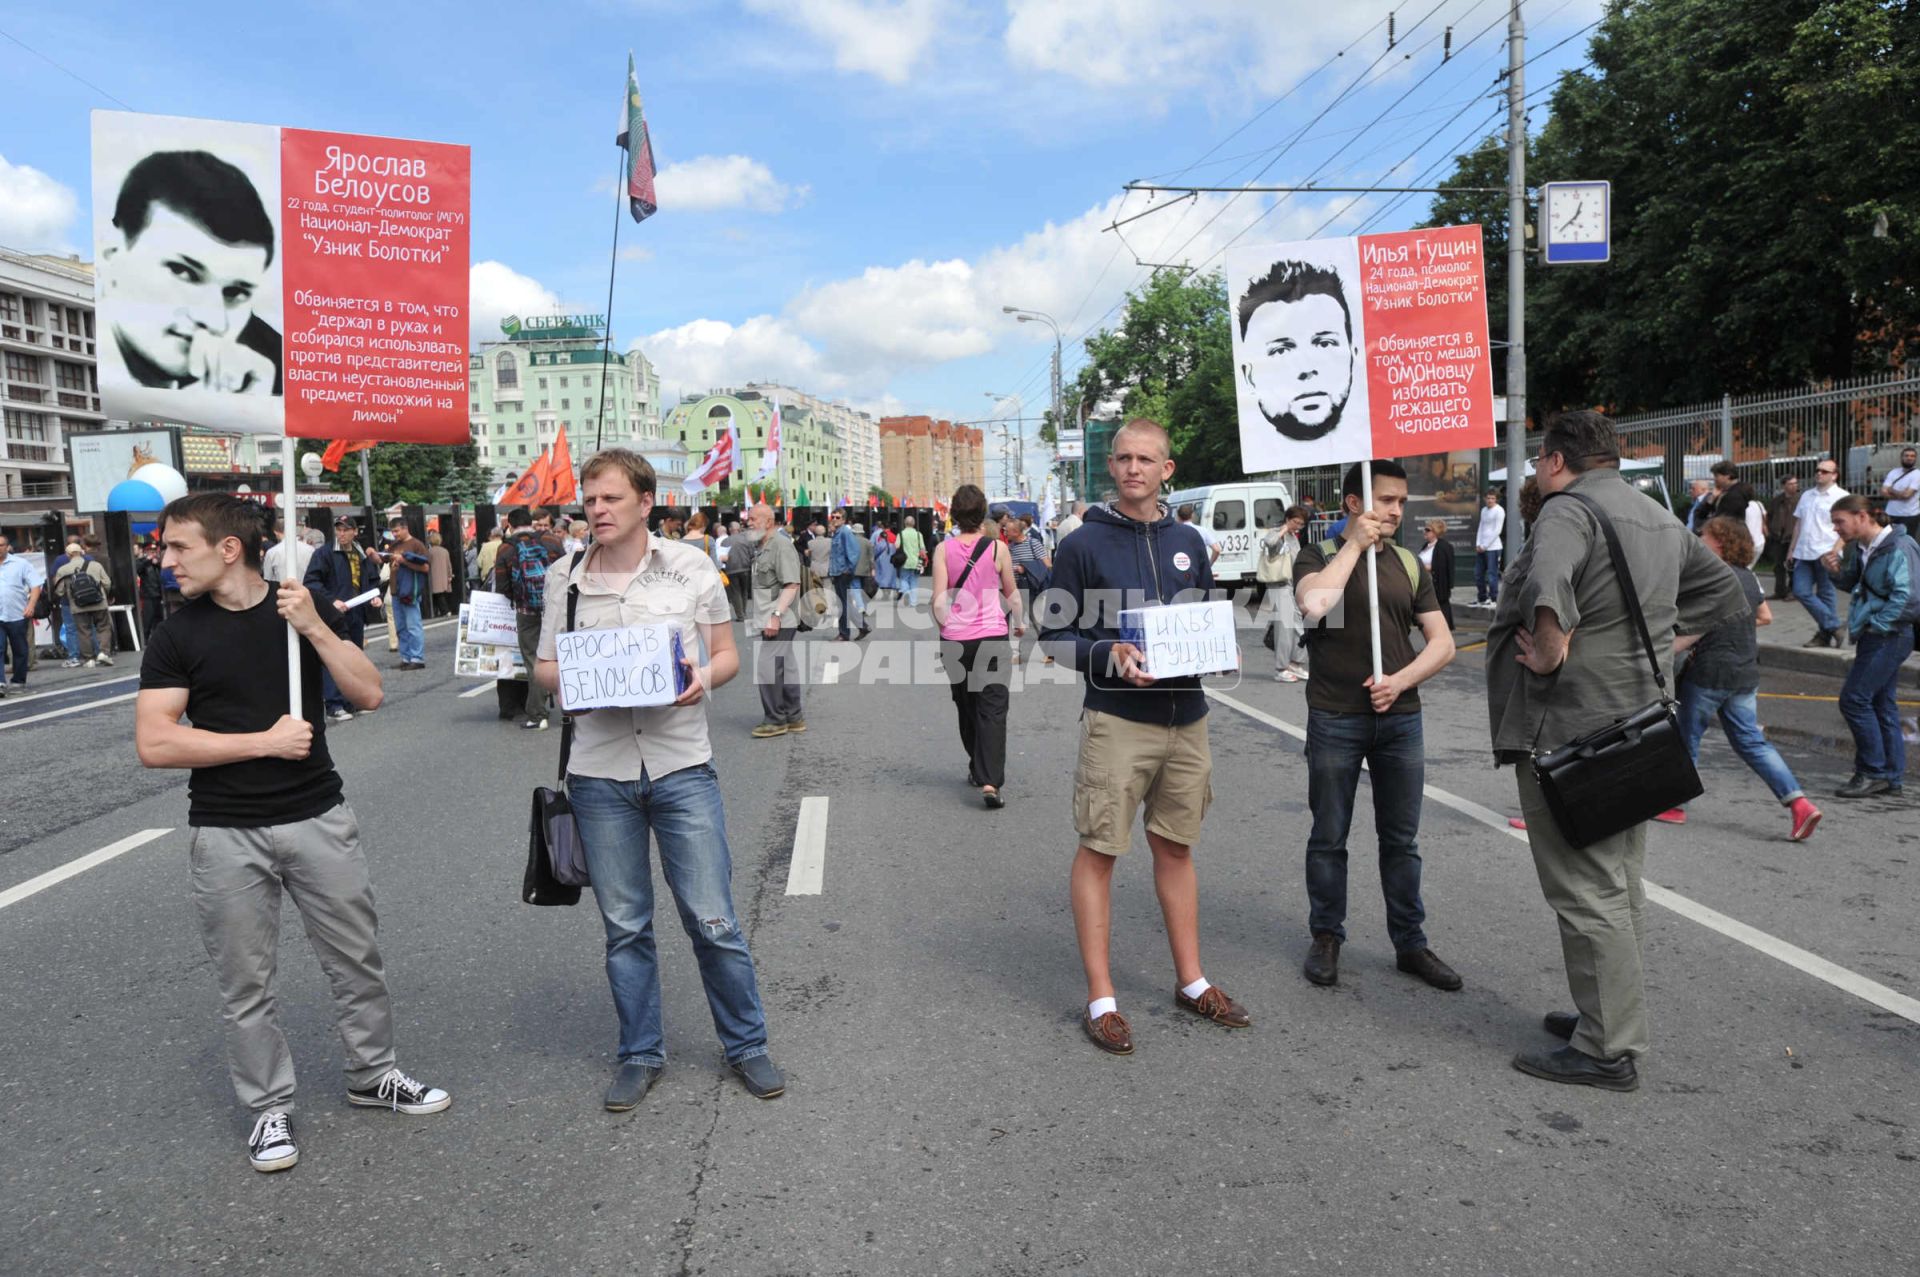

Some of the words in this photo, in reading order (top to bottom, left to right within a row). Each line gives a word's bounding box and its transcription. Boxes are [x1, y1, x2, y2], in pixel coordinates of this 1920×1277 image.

[325, 146, 426, 178] Ярослав
[315, 170, 430, 208] Белоусов
[288, 198, 299, 209] 22
[303, 200, 330, 212] года,
[333, 204, 434, 221] студент-политолог
[436, 211, 464, 224] (МГУ)
[300, 213, 452, 244] Национал-Демократ
[303, 234, 362, 257] “Узник
[369, 240, 449, 263] Болотки”
[1363, 243, 1408, 264] Илья
[1416, 239, 1476, 264] Гущин
[1370, 267, 1382, 280] 24
[1388, 266, 1417, 278] года,
[1422, 261, 1472, 275] психолог
[1366, 276, 1478, 294] Национал-Демократ
[294, 290, 379, 311] Обвиняется
[384, 302, 392, 312] в
[399, 302, 429, 316] том,
[434, 306, 458, 318] что
[312, 311, 372, 331] “держал
[377, 320, 385, 330] в
[391, 321, 428, 336] руках
[434, 324, 442, 334] и
[526, 314, 606, 329] СБЕРБАНК
[292, 328, 364, 349] собирался
[1380, 334, 1460, 352] Обвиняется
[1466, 332, 1473, 343] в
[291, 351, 342, 365] против
[347, 354, 462, 374] представителей
[1374, 355, 1404, 367] том,
[1408, 351, 1432, 363] что
[1437, 346, 1480, 360] мешал
[289, 369, 337, 382] власти
[342, 374, 464, 391] неустановленный
[1388, 364, 1474, 384] ОМОНовцу
[302, 389, 368, 404] предмет,
[372, 393, 432, 408] похожий
[438, 398, 452, 409] на
[1392, 382, 1467, 400] избивать
[352, 409, 403, 423] лимон”
[1388, 398, 1471, 420] лежащего
[1395, 414, 1468, 434] человека
[1156, 608, 1215, 636] ИЛЬЯ
[558, 628, 659, 664] ЯРОСЛАВ
[1152, 635, 1228, 670] ГУЩИН
[561, 664, 666, 706] БЕЛОУСОВ
